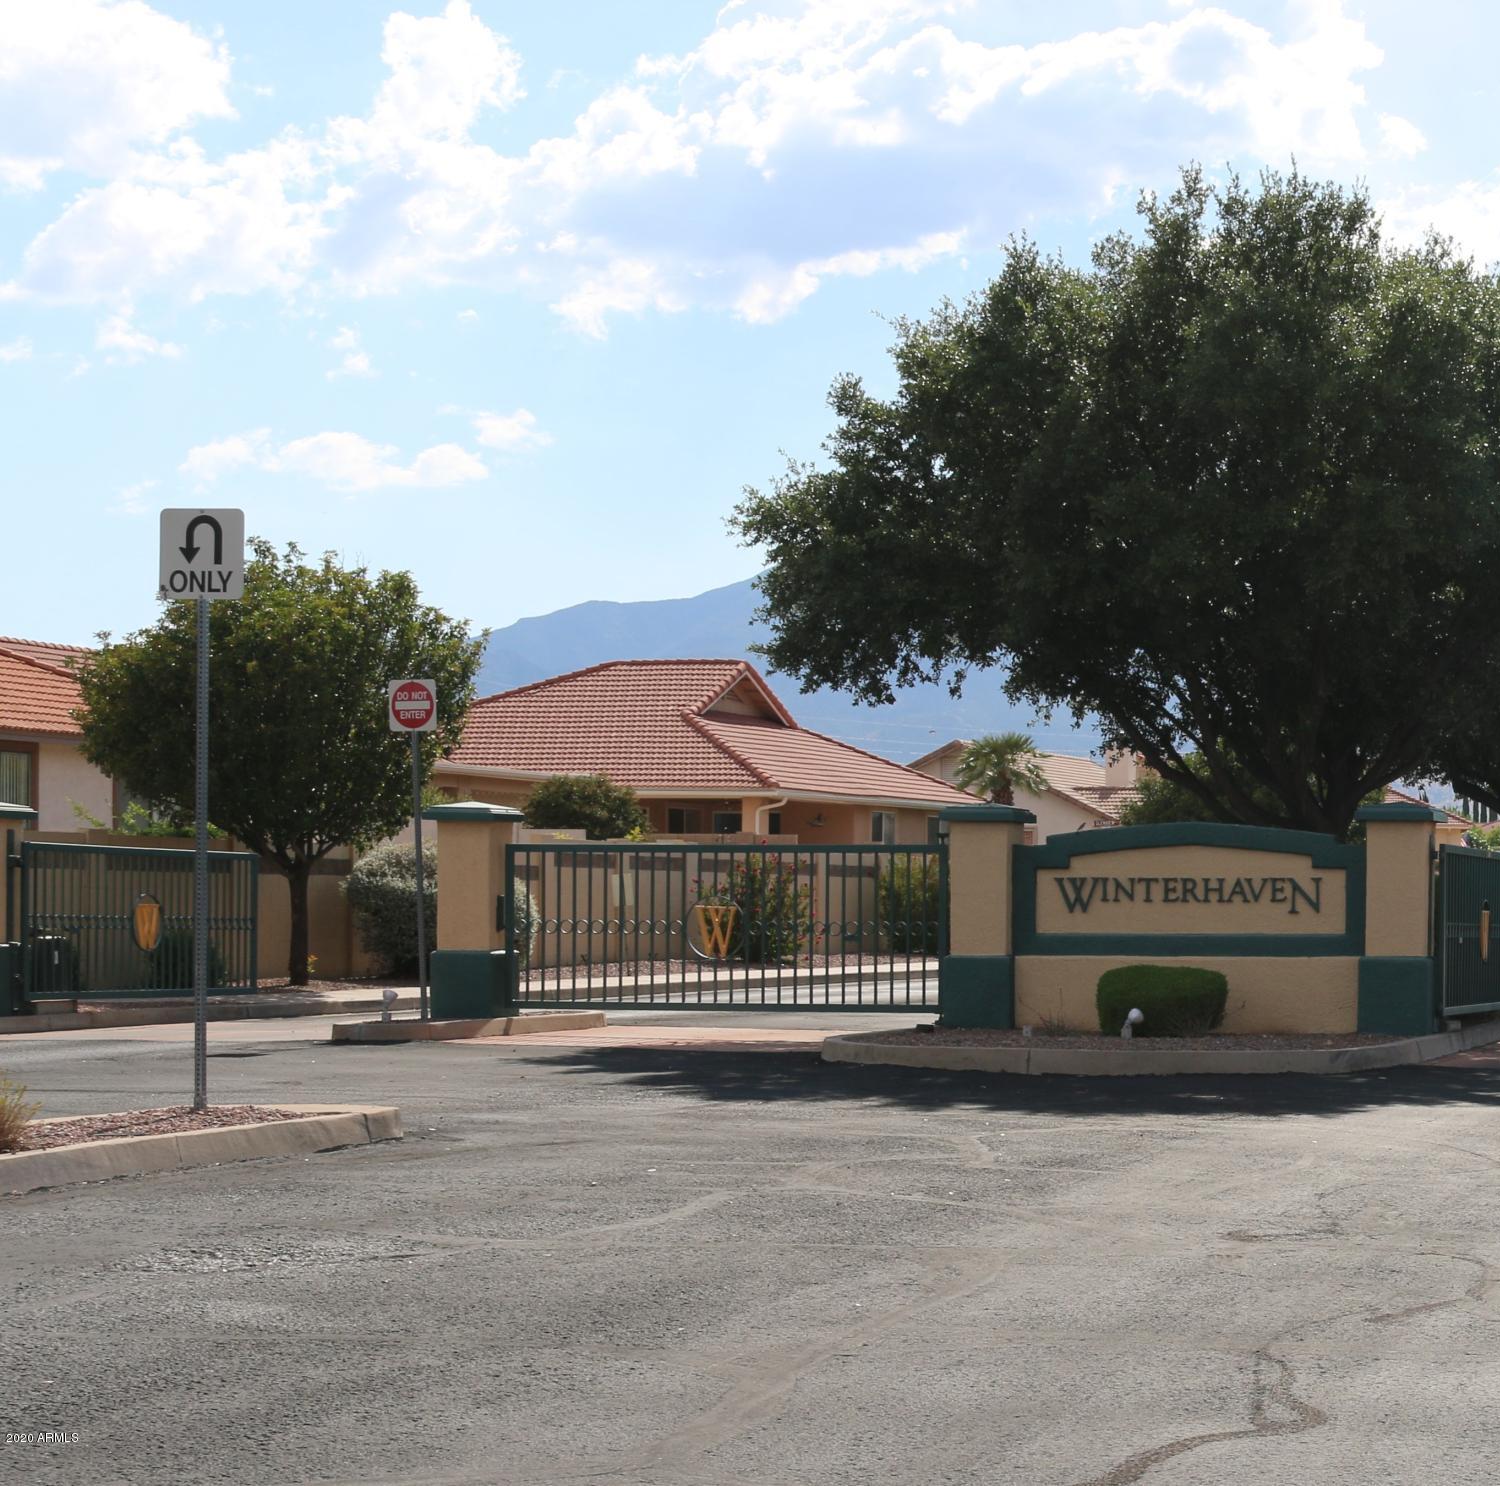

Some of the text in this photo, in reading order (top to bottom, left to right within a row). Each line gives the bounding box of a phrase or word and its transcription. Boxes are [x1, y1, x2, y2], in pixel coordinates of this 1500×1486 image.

[169, 569, 233, 593] ONLY
[397, 691, 427, 700] DO NOT
[400, 710, 426, 720] ENTER
[1054, 877, 1323, 914] WINTERHAVEN
[694, 905, 737, 957] W
